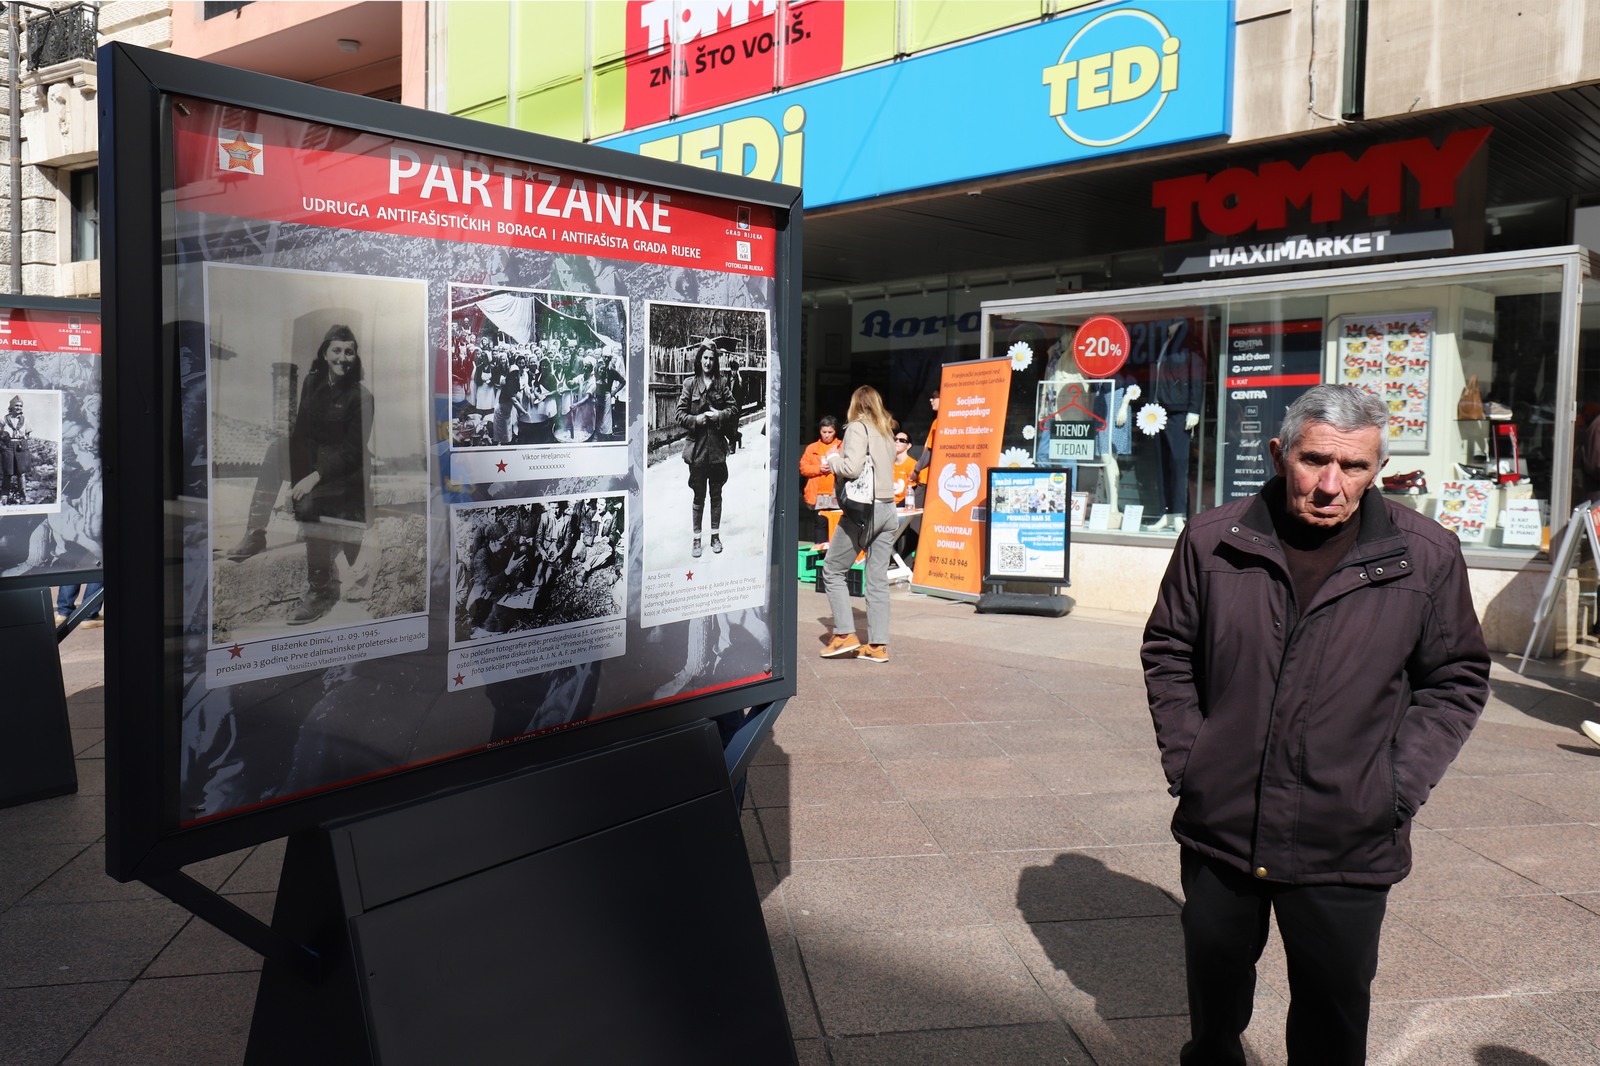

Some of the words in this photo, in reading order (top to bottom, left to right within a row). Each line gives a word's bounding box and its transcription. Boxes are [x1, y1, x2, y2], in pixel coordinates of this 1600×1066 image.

[695, 44, 735, 73] ŠTO
[1152, 125, 1494, 243] TOMMY
[302, 196, 370, 217] UDRUGA
[376, 206, 491, 232] ANTIFAŠISTIČKIH
[497, 221, 547, 240] BORACA
[552, 228, 556, 240] I
[561, 229, 629, 250] ANTIFAŠISTA
[633, 239, 668, 255] GRADA
[671, 244, 701, 259] RIJEKE
[725, 229, 741, 237] GRAD
[744, 232, 763, 240] RIJEKA
[1209, 230, 1391, 267] MAXIMARKET
[725, 261, 748, 270] FOTOKLUB
[749, 264, 764, 272] RIJEKA
[12, 338, 38, 347] RIJEKE
[1078, 336, 1122, 358] -20%
[1233, 338, 1264, 348] CENTRA
[956, 395, 985, 407] Socijalna
[1231, 390, 1268, 400] CENTRA
[948, 406, 990, 418] samoposluga
[965, 426, 989, 434] Elizabete
[1055, 423, 1090, 437] TRENDY
[1056, 443, 1088, 456] TJEDAN
[522, 453, 540, 461] Viktor
[1236, 454, 1257, 462] Kenny
[933, 524, 973, 536] VOLONTIRAJ!
[936, 539, 965, 550] DONIRAJ!
[949, 558, 956, 566] 63
[957, 559, 968, 568] 946
[271, 639, 308, 652] Blaženke
[309, 634, 333, 647] Dimić,
[337, 634, 346, 642] 12.
[348, 632, 360, 643] 09.
[362, 629, 381, 639] 1945.
[460, 652, 469, 660] Na
[495, 641, 528, 655] fotografije
[528, 637, 543, 650] piše:
[542, 631, 577, 648] predsjednica
[216, 661, 252, 677] proslava
[253, 661, 258, 671] 3
[260, 653, 289, 671] godine
[290, 650, 309, 662] Prve
[310, 644, 356, 659] dalmatinske
[357, 636, 398, 652] proleterske
[399, 631, 426, 646] brigade
[456, 658, 480, 670] ostalim
[480, 651, 510, 666] članovima
[510, 647, 536, 660] diskutira
[536, 643, 554, 655] članak
[617, 630, 623, 639] te
[285, 659, 318, 672] Vlasništvo
[318, 654, 347, 667] Vladimira
[347, 650, 368, 661] Dimića
[471, 667, 485, 677] foto
[485, 660, 505, 674] sekcija
[505, 655, 539, 672] prop-odjela
[575, 644, 588, 655] Hrv.
[588, 640, 611, 653] Primorje.
